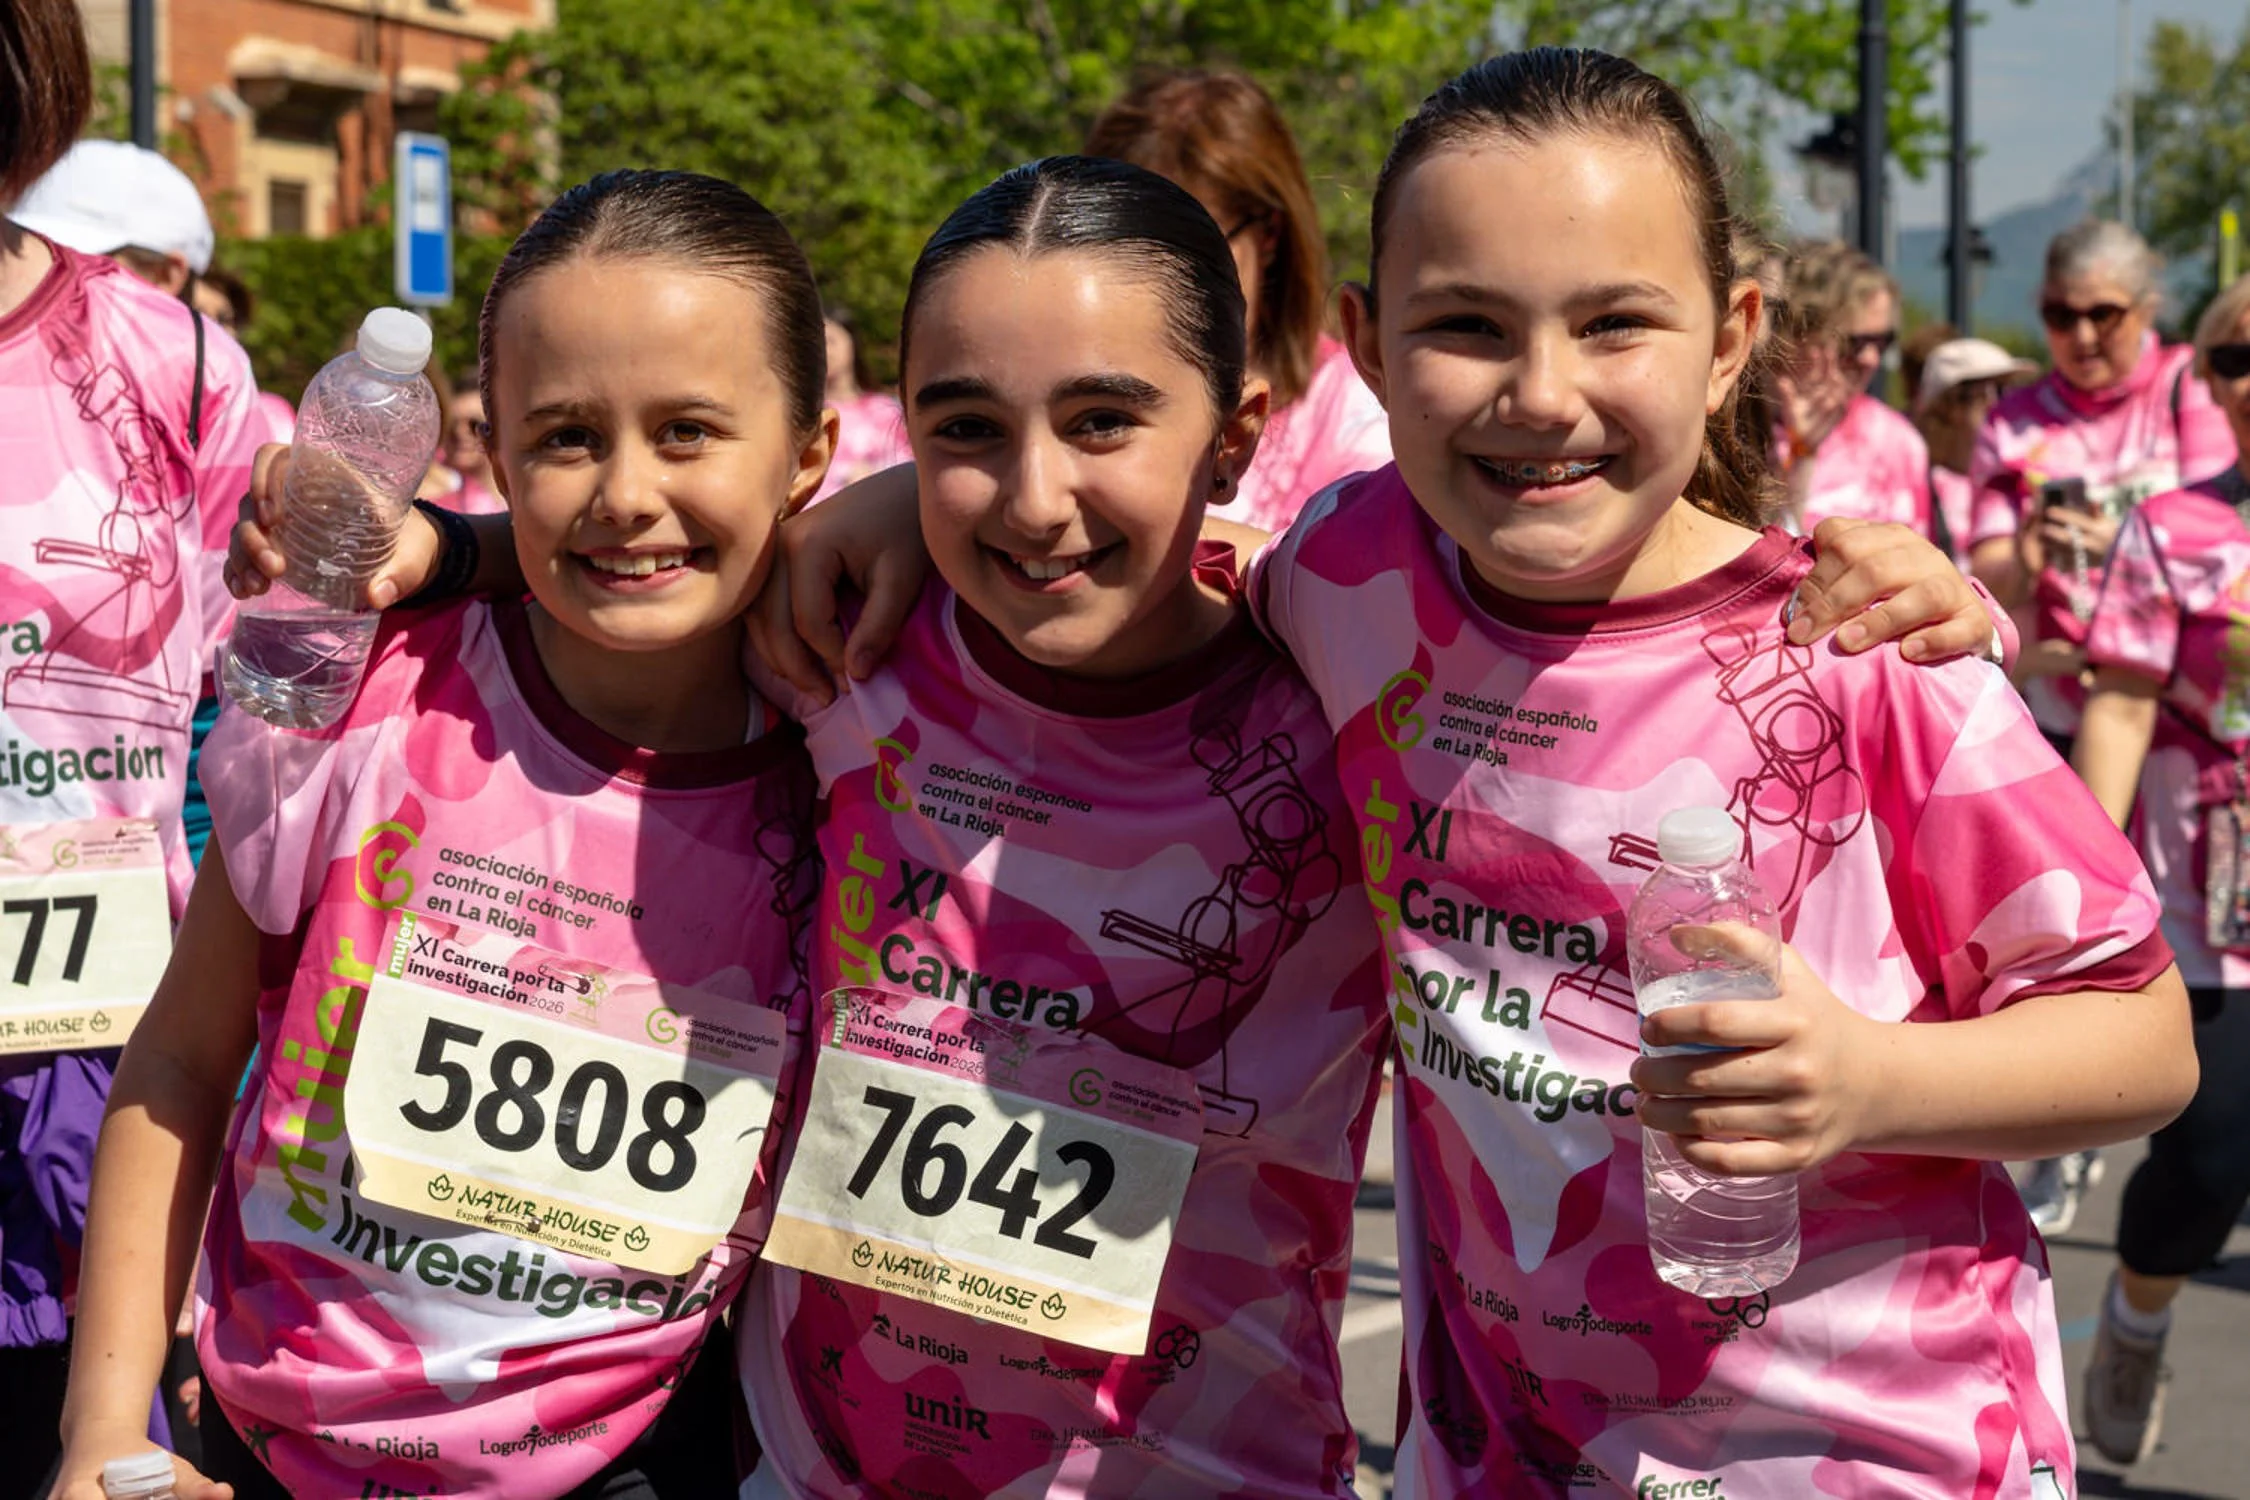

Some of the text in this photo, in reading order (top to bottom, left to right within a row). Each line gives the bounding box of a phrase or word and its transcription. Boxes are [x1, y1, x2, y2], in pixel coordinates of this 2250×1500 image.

[1439, 714, 1559, 750] contra el cáncer
[1443, 690, 1598, 732] asociación española
[1433, 736, 1508, 767] en La Rioja
[921, 782, 1052, 826] contra el cáncer
[929, 763, 1012, 794] asociación
[918, 801, 1006, 838] en La Rioja
[1403, 801, 1452, 863] XI
[433, 871, 595, 930] contra el cáncer
[439, 847, 644, 920] asociación española
[888, 859, 948, 922] XI
[427, 895, 537, 938] en La Rioja
[1400, 878, 1598, 966] Carrera
[389, 917, 414, 974] mujer
[413, 934, 565, 994] XI Carrera por la
[408, 959, 565, 1014] investigación 2026
[880, 933, 1080, 1030] Carrera
[1481, 969, 1531, 1030] la
[24, 1017, 85, 1036] HOUSE
[845, 1028, 950, 1066] investigación
[873, 1015, 932, 1041] Carrera
[935, 1031, 967, 1050] por
[969, 1036, 986, 1054] la
[1421, 1014, 1641, 1123] Investigac
[399, 1016, 707, 1193] 5808
[847, 1085, 1115, 1260] 7642
[458, 1184, 621, 1243] NATUR HOUSE
[561, 1237, 567, 1246] y
[568, 1238, 612, 1258] Dietética
[875, 1276, 1028, 1326] Expertos en Nutrición y Dietética
[877, 1251, 952, 1285] NATUR
[958, 1272, 1038, 1309] HOUSE
[1468, 1283, 1519, 1323] La Rioja
[896, 1327, 969, 1365] La Rioja
[376, 1436, 440, 1461] Rioja
